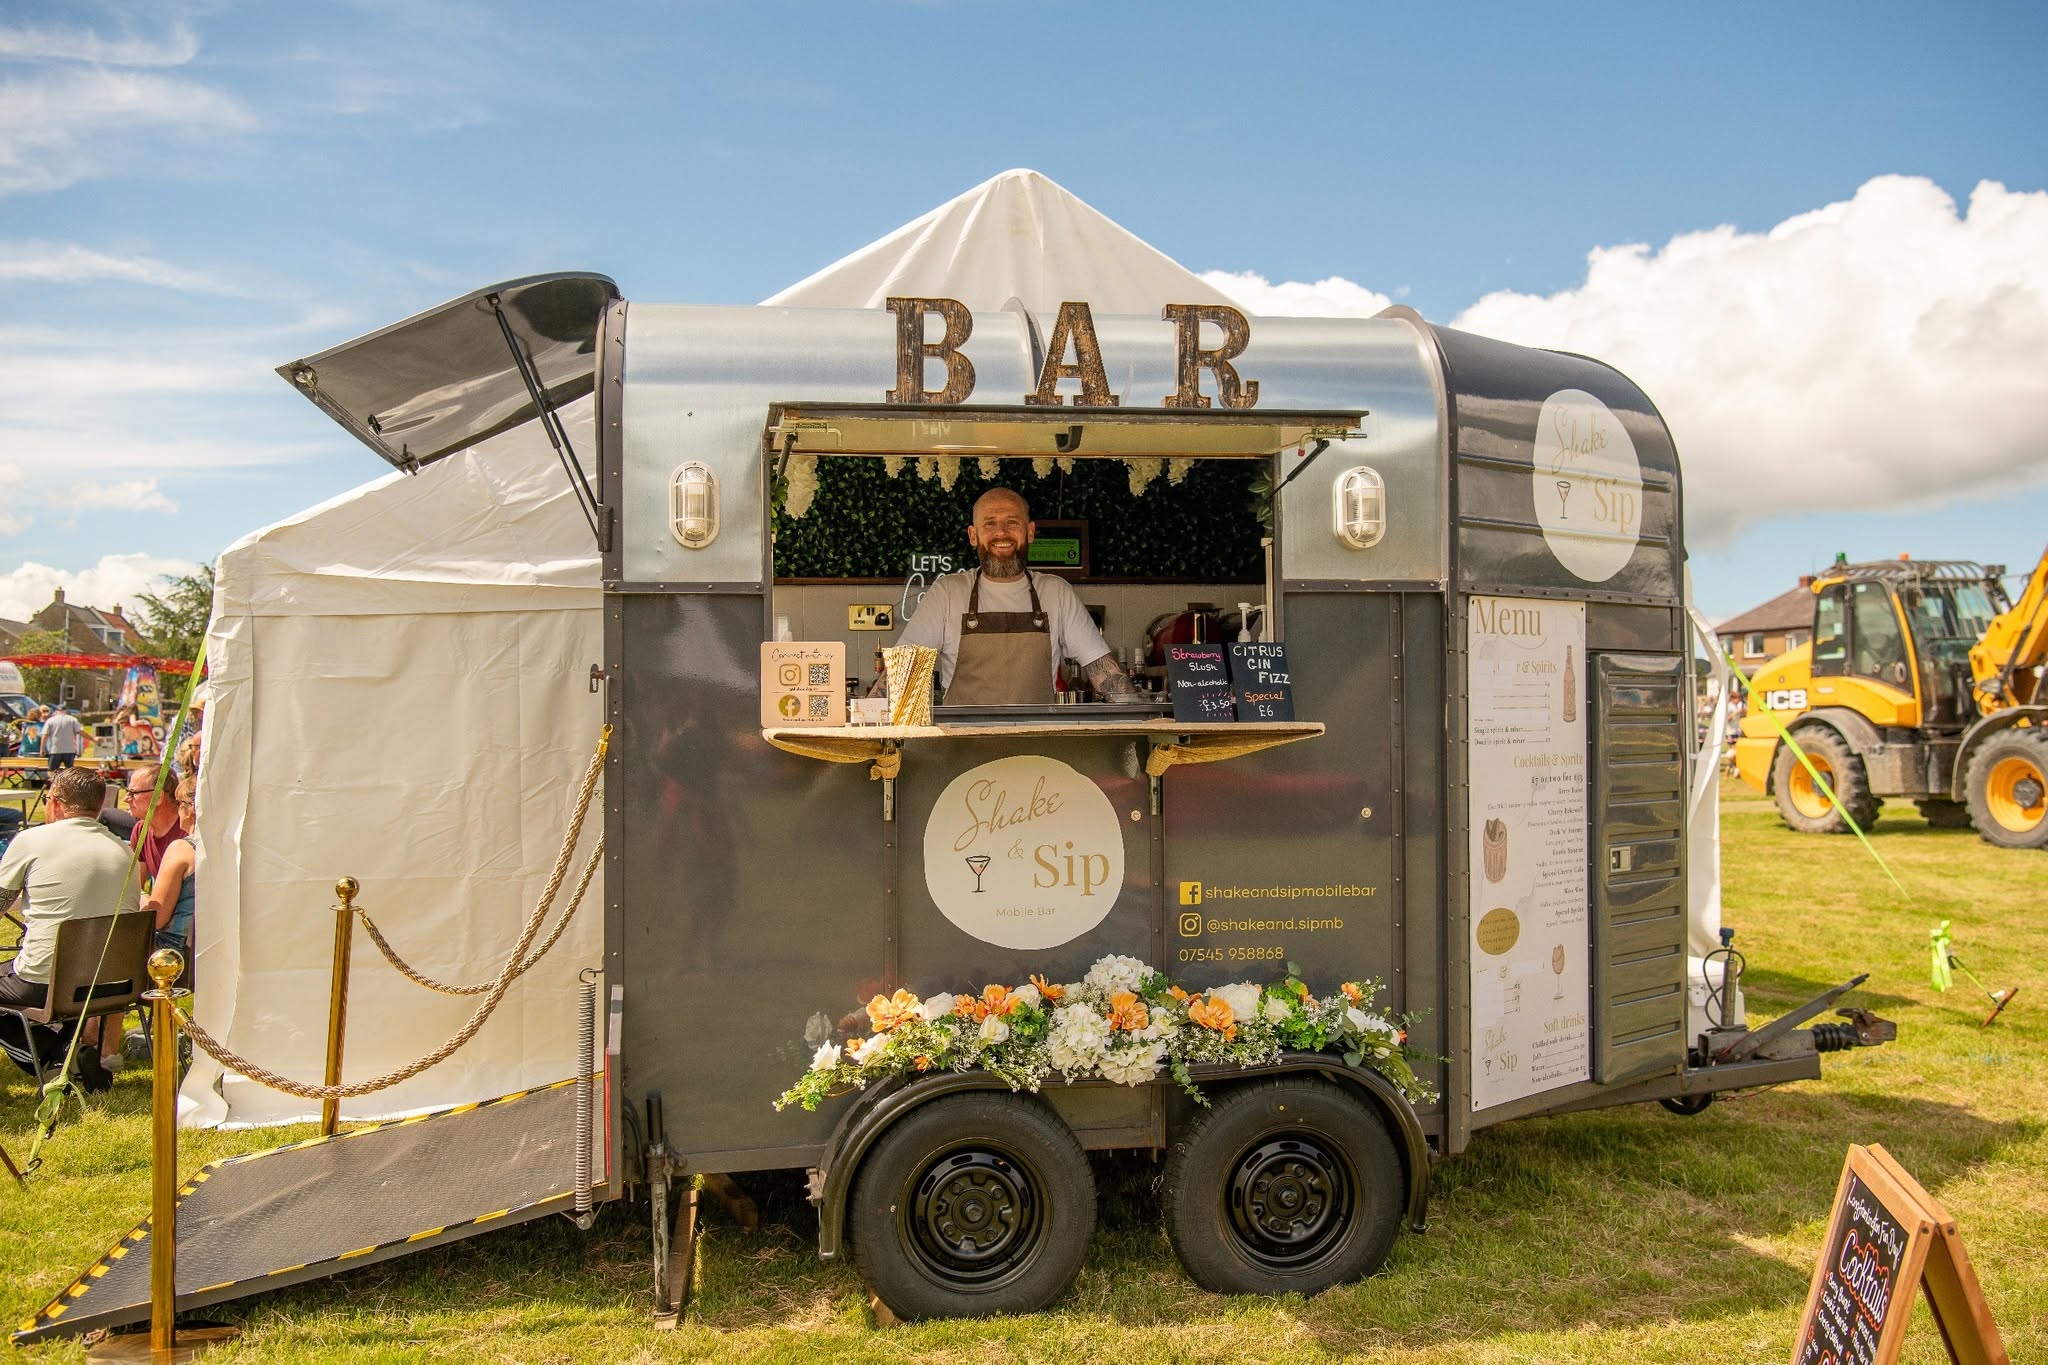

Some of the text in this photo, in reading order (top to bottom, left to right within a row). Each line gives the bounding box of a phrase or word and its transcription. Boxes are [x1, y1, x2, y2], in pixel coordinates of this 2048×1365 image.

[886, 297, 1259, 410] BAR
[1552, 407, 1609, 474] Shake
[1593, 478, 1635, 534] Sip
[912, 554, 952, 572] LET'S
[1474, 599, 1542, 636] Menu
[1171, 647, 1222, 661] Strawberry
[1233, 645, 1283, 657] CITRUS
[1247, 658, 1271, 669] GIN
[1521, 661, 1530, 673] &
[1531, 660, 1557, 675] Spirits
[1177, 678, 1228, 688] Non-alcoholic
[1259, 672, 1291, 684] FIZZ
[1202, 699, 1230, 711] £3.50
[1244, 691, 1284, 705] Special
[1760, 690, 1807, 710] JCB
[1258, 705, 1274, 717] £6
[1513, 754, 1550, 768] Cocktails
[1551, 754, 1559, 766] &
[953, 775, 1064, 852] Shake
[1007, 838, 1024, 860] &
[1033, 841, 1110, 896] Sip
[1205, 884, 1377, 899] shakeandsipmobilebar
[996, 906, 1056, 918] Mobile Bar
[1207, 917, 1343, 933] @shakeand.sipmb
[1179, 947, 1284, 961] 07545 958868
[1544, 1013, 1584, 1033] Soft drinks
[1499, 1050, 1518, 1072] Sip
[1878, 1221, 1889, 1245] Fun
[1840, 1231, 1888, 1324] Cocktails
